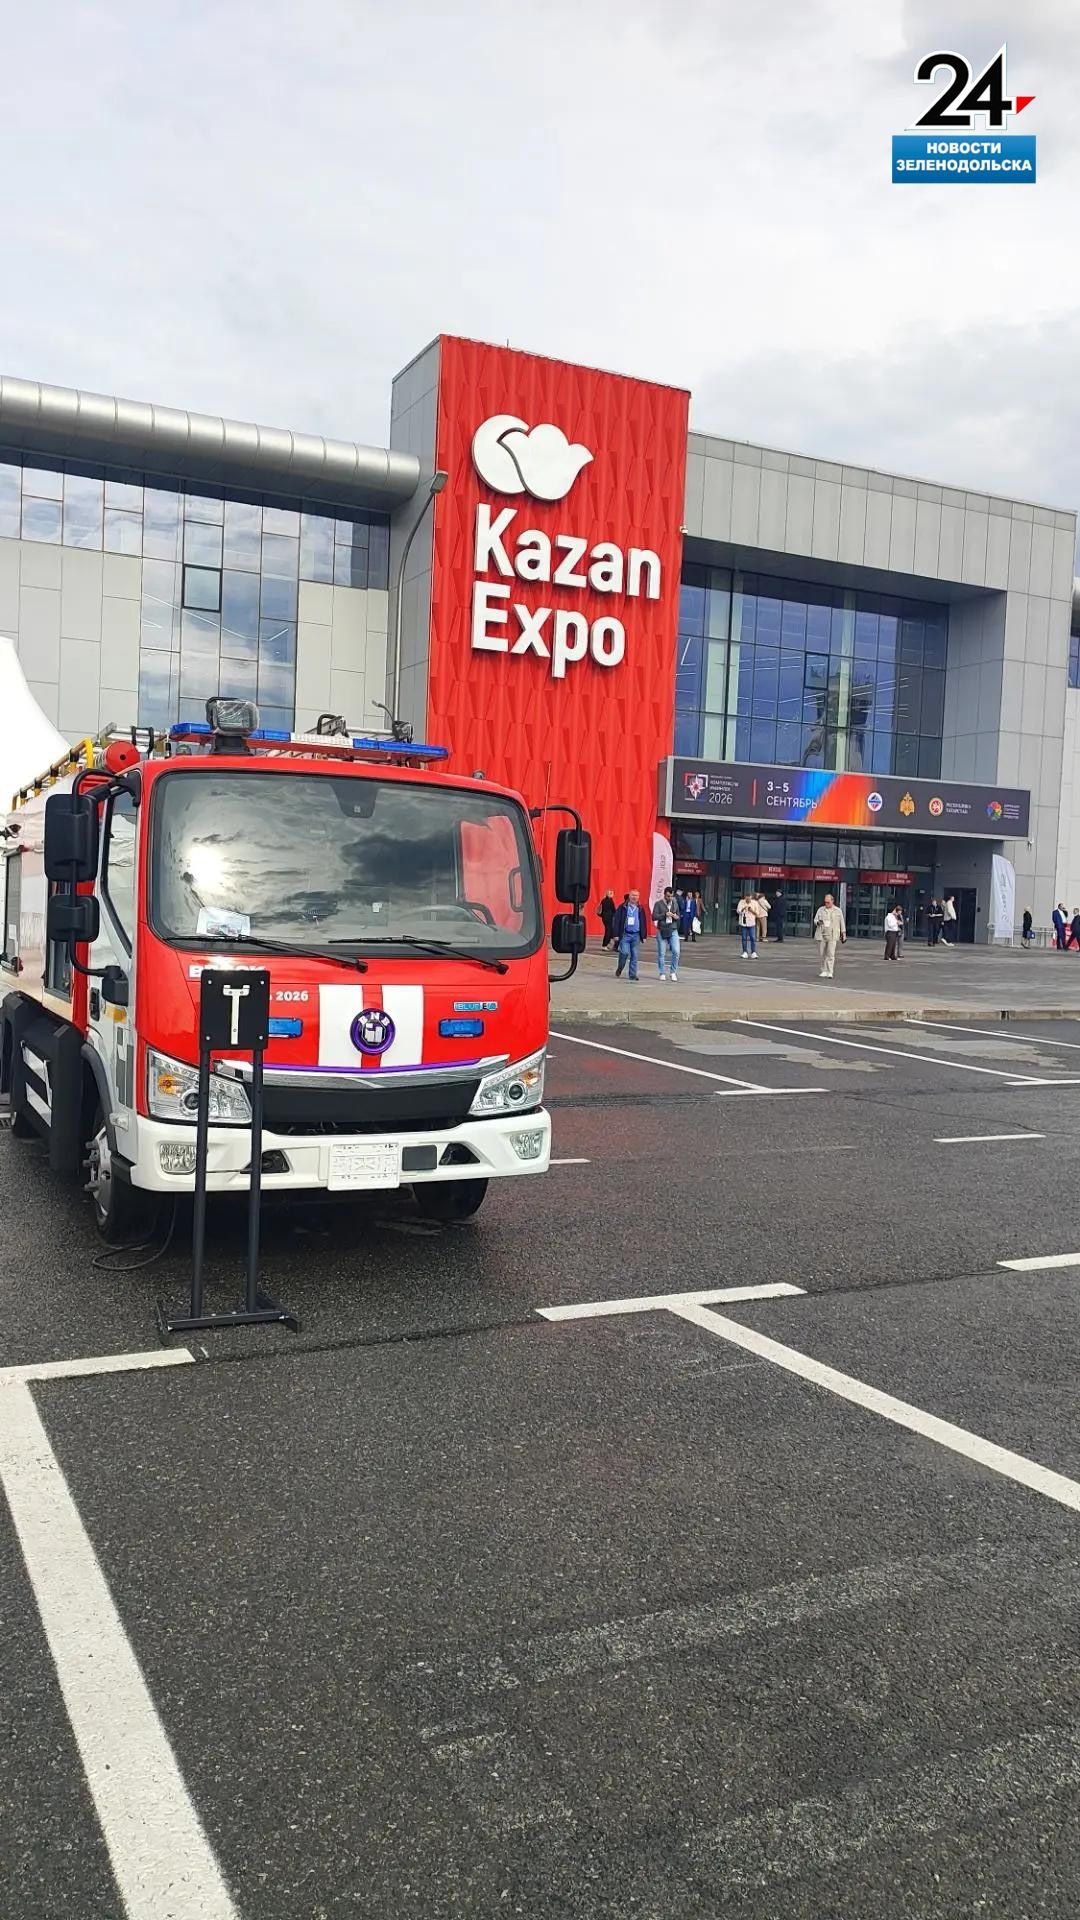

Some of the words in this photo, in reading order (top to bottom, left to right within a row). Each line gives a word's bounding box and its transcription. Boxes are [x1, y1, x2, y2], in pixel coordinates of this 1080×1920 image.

[474, 503, 661, 600] Kazan
[471, 580, 625, 678] Expo
[708, 792, 733, 804] 2026
[766, 795, 818, 809] СЕНТЯБРЬ
[275, 990, 309, 1002] 2026
